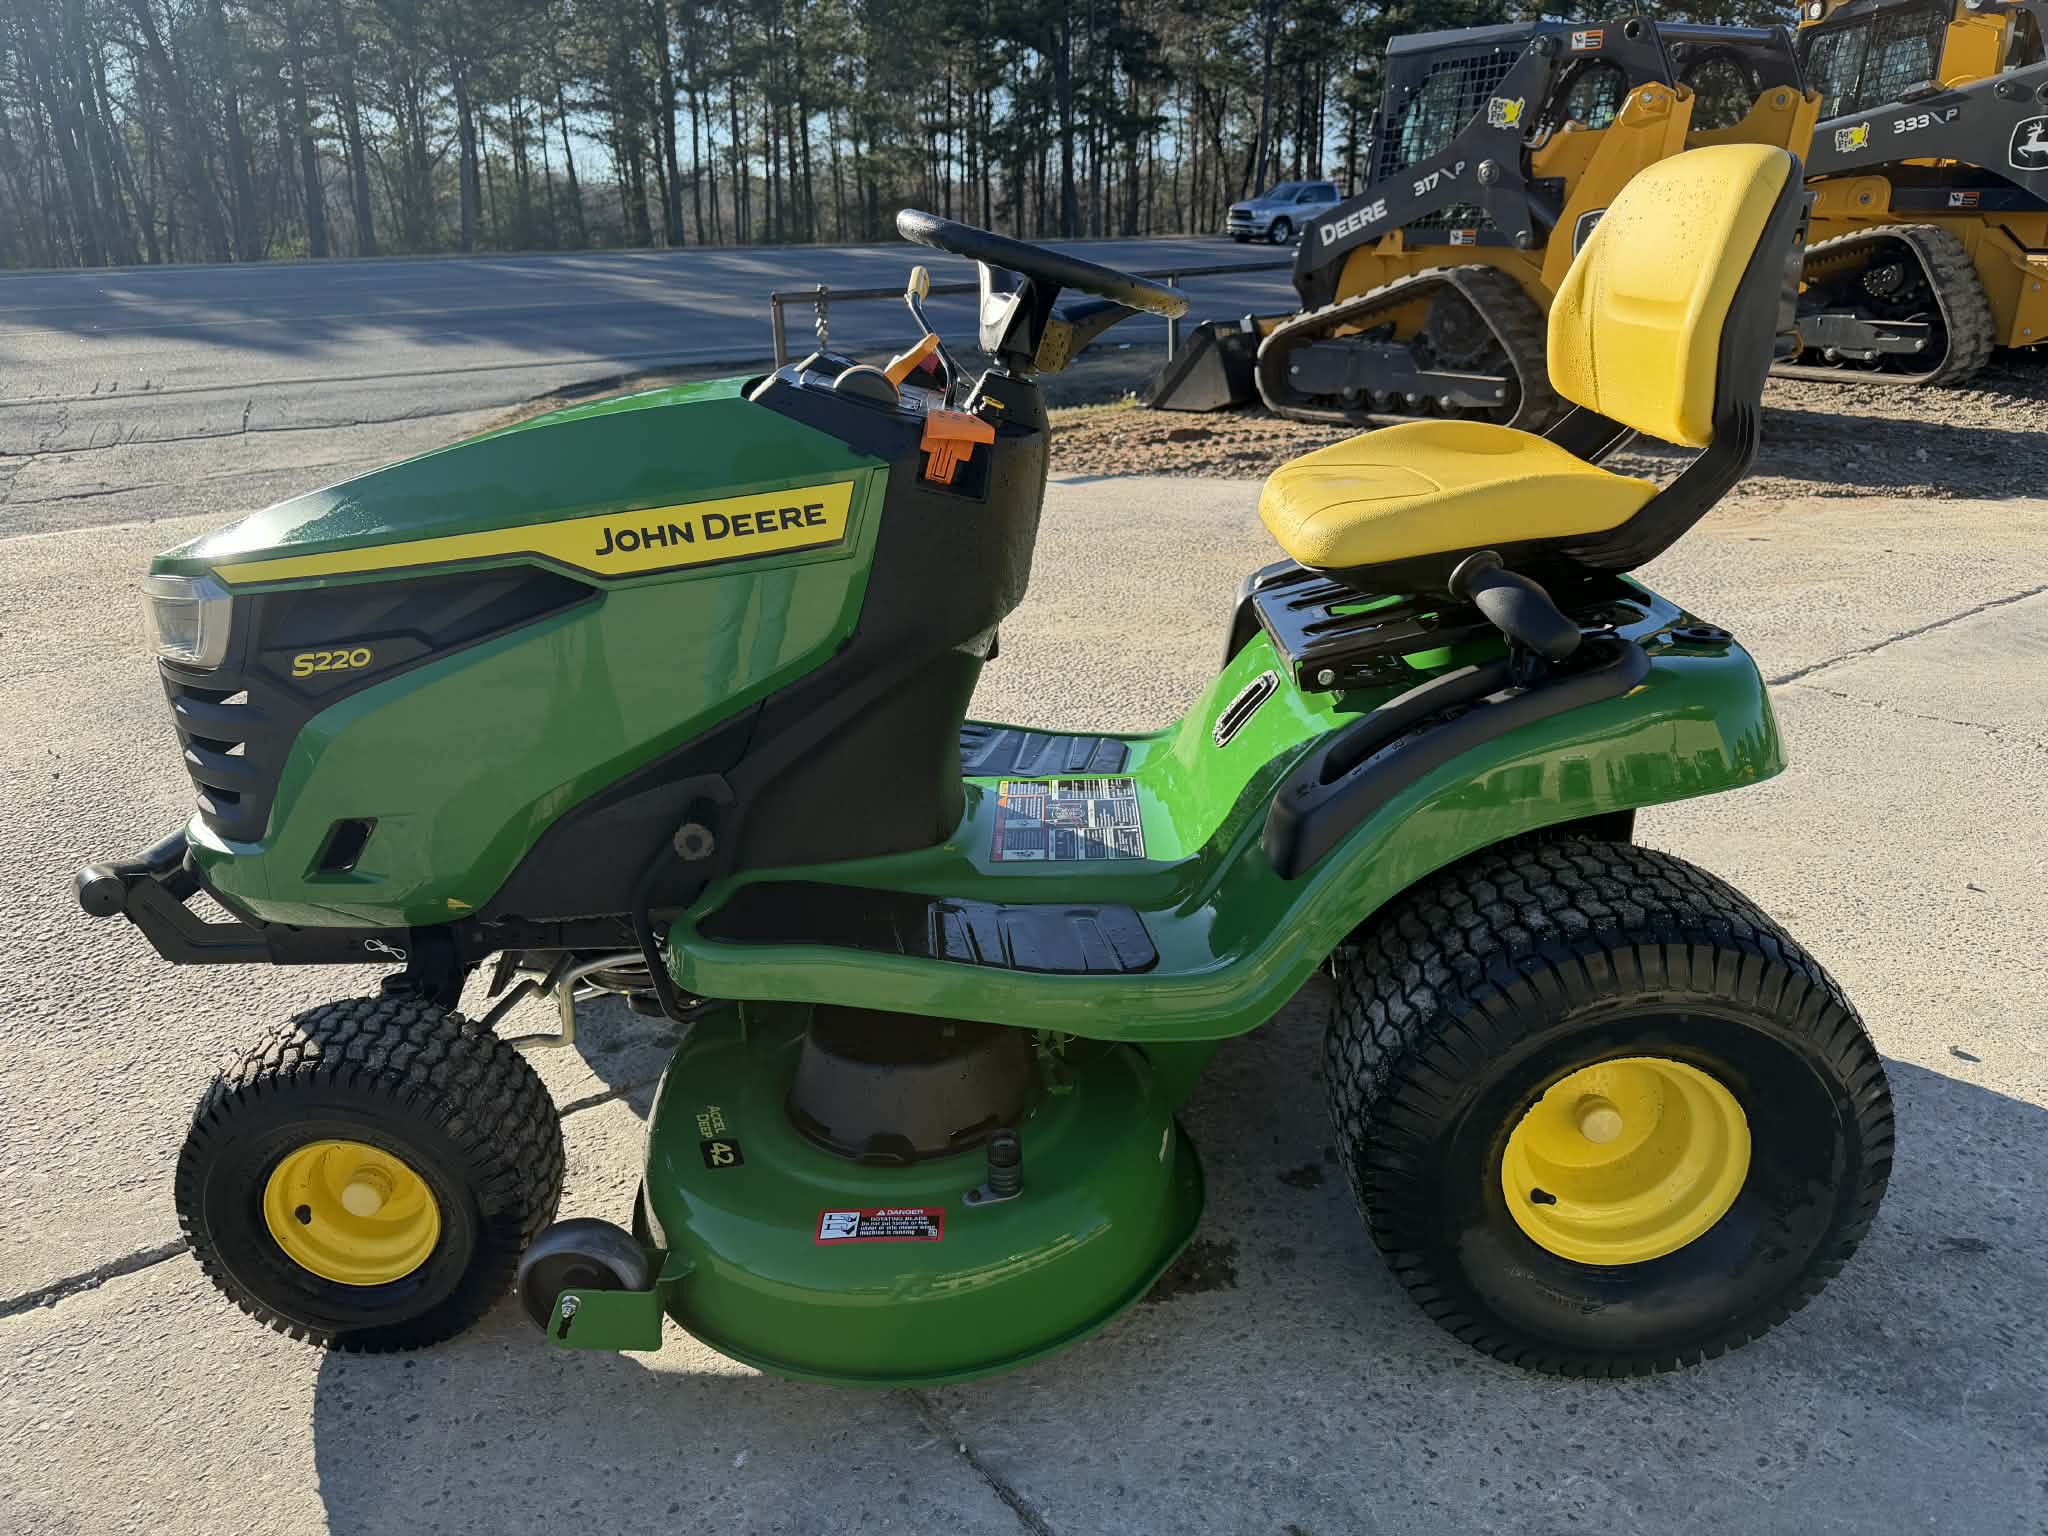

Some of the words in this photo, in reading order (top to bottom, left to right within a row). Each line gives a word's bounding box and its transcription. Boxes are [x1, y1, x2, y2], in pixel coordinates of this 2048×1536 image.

[1320, 198, 1388, 246] DEERE
[595, 522, 695, 556] JOHN
[702, 503, 827, 541] DEERE
[292, 648, 371, 677] S220
[696, 1114, 713, 1138] DEEP
[710, 1142, 734, 1166] 42
